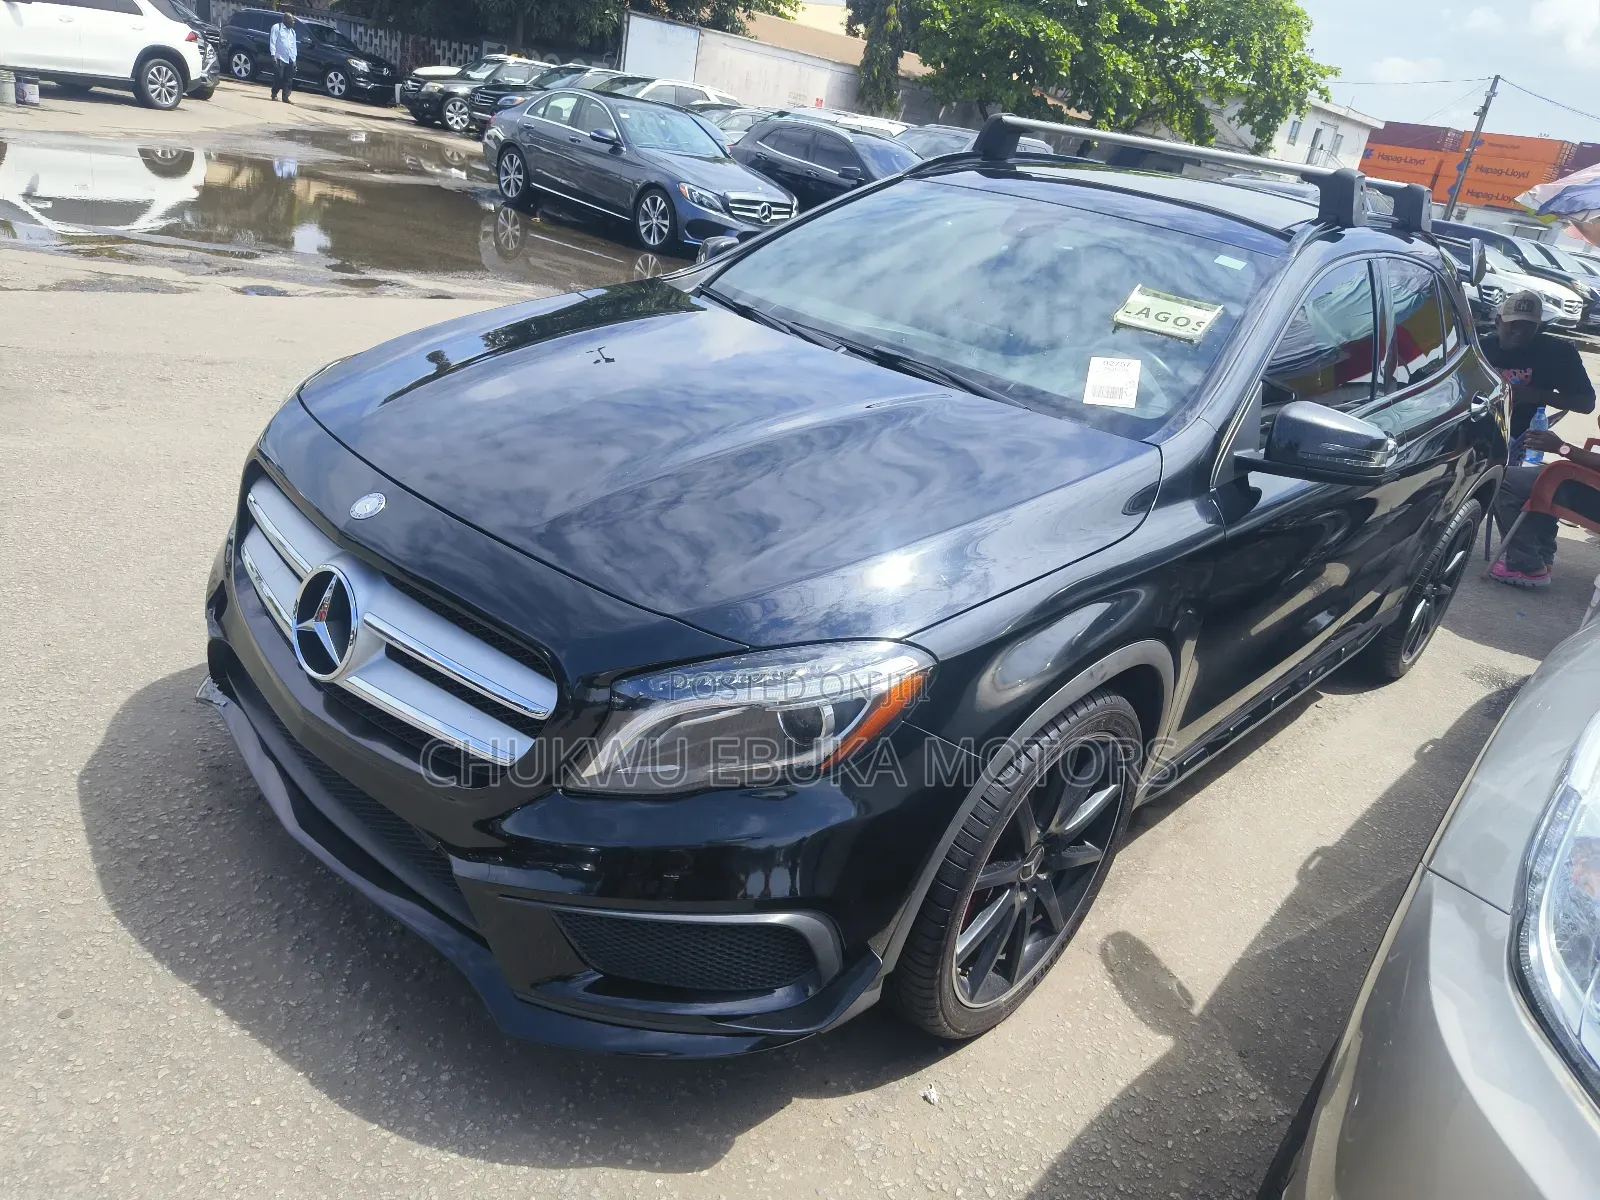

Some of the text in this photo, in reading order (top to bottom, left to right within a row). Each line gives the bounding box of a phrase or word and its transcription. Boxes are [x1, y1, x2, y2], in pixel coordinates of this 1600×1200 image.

[1377, 152, 1426, 166] Hapag-Lloyd
[1475, 164, 1530, 179] Hapag-Lloyd
[1125, 306, 1206, 332] AGOS
